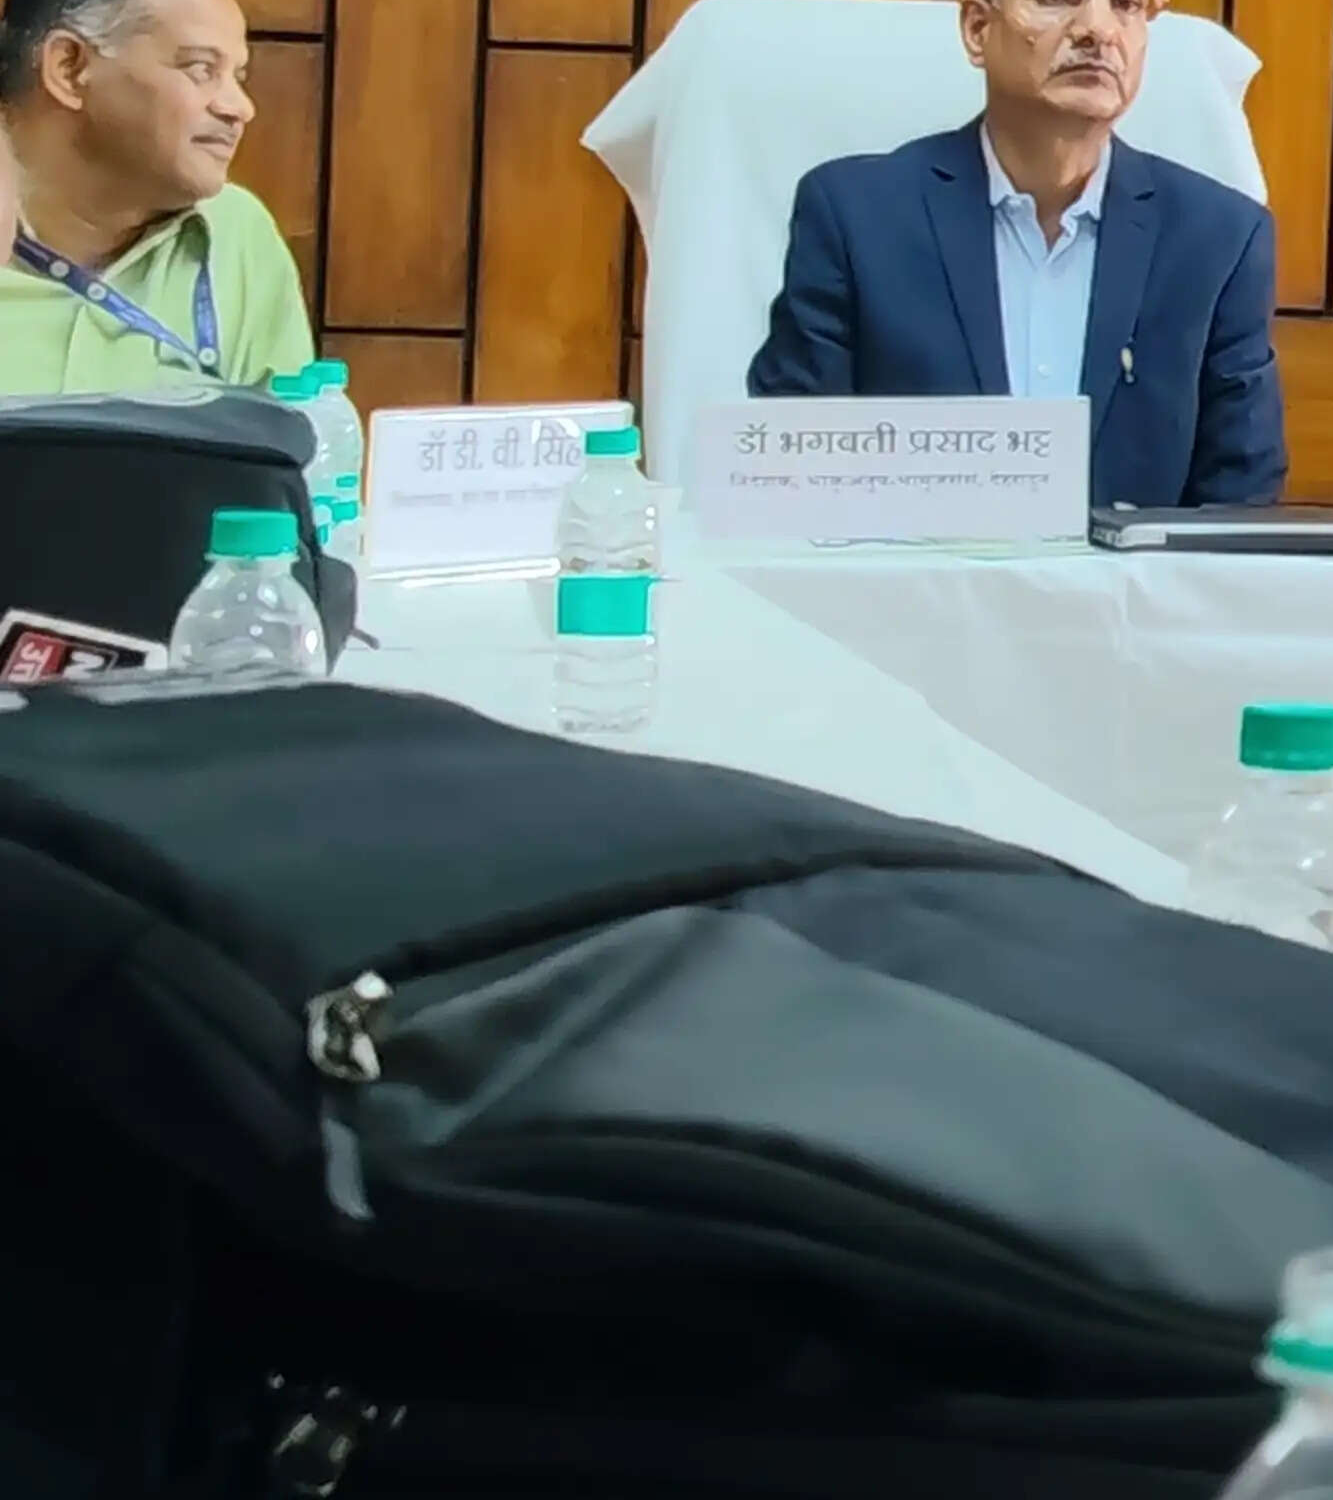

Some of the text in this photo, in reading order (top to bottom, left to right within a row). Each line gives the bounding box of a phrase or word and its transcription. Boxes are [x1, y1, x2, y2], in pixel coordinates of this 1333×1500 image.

[417, 428, 447, 472] डॉ
[732, 421, 1053, 458] डॉ भगवती प्रसाद भट्ट
